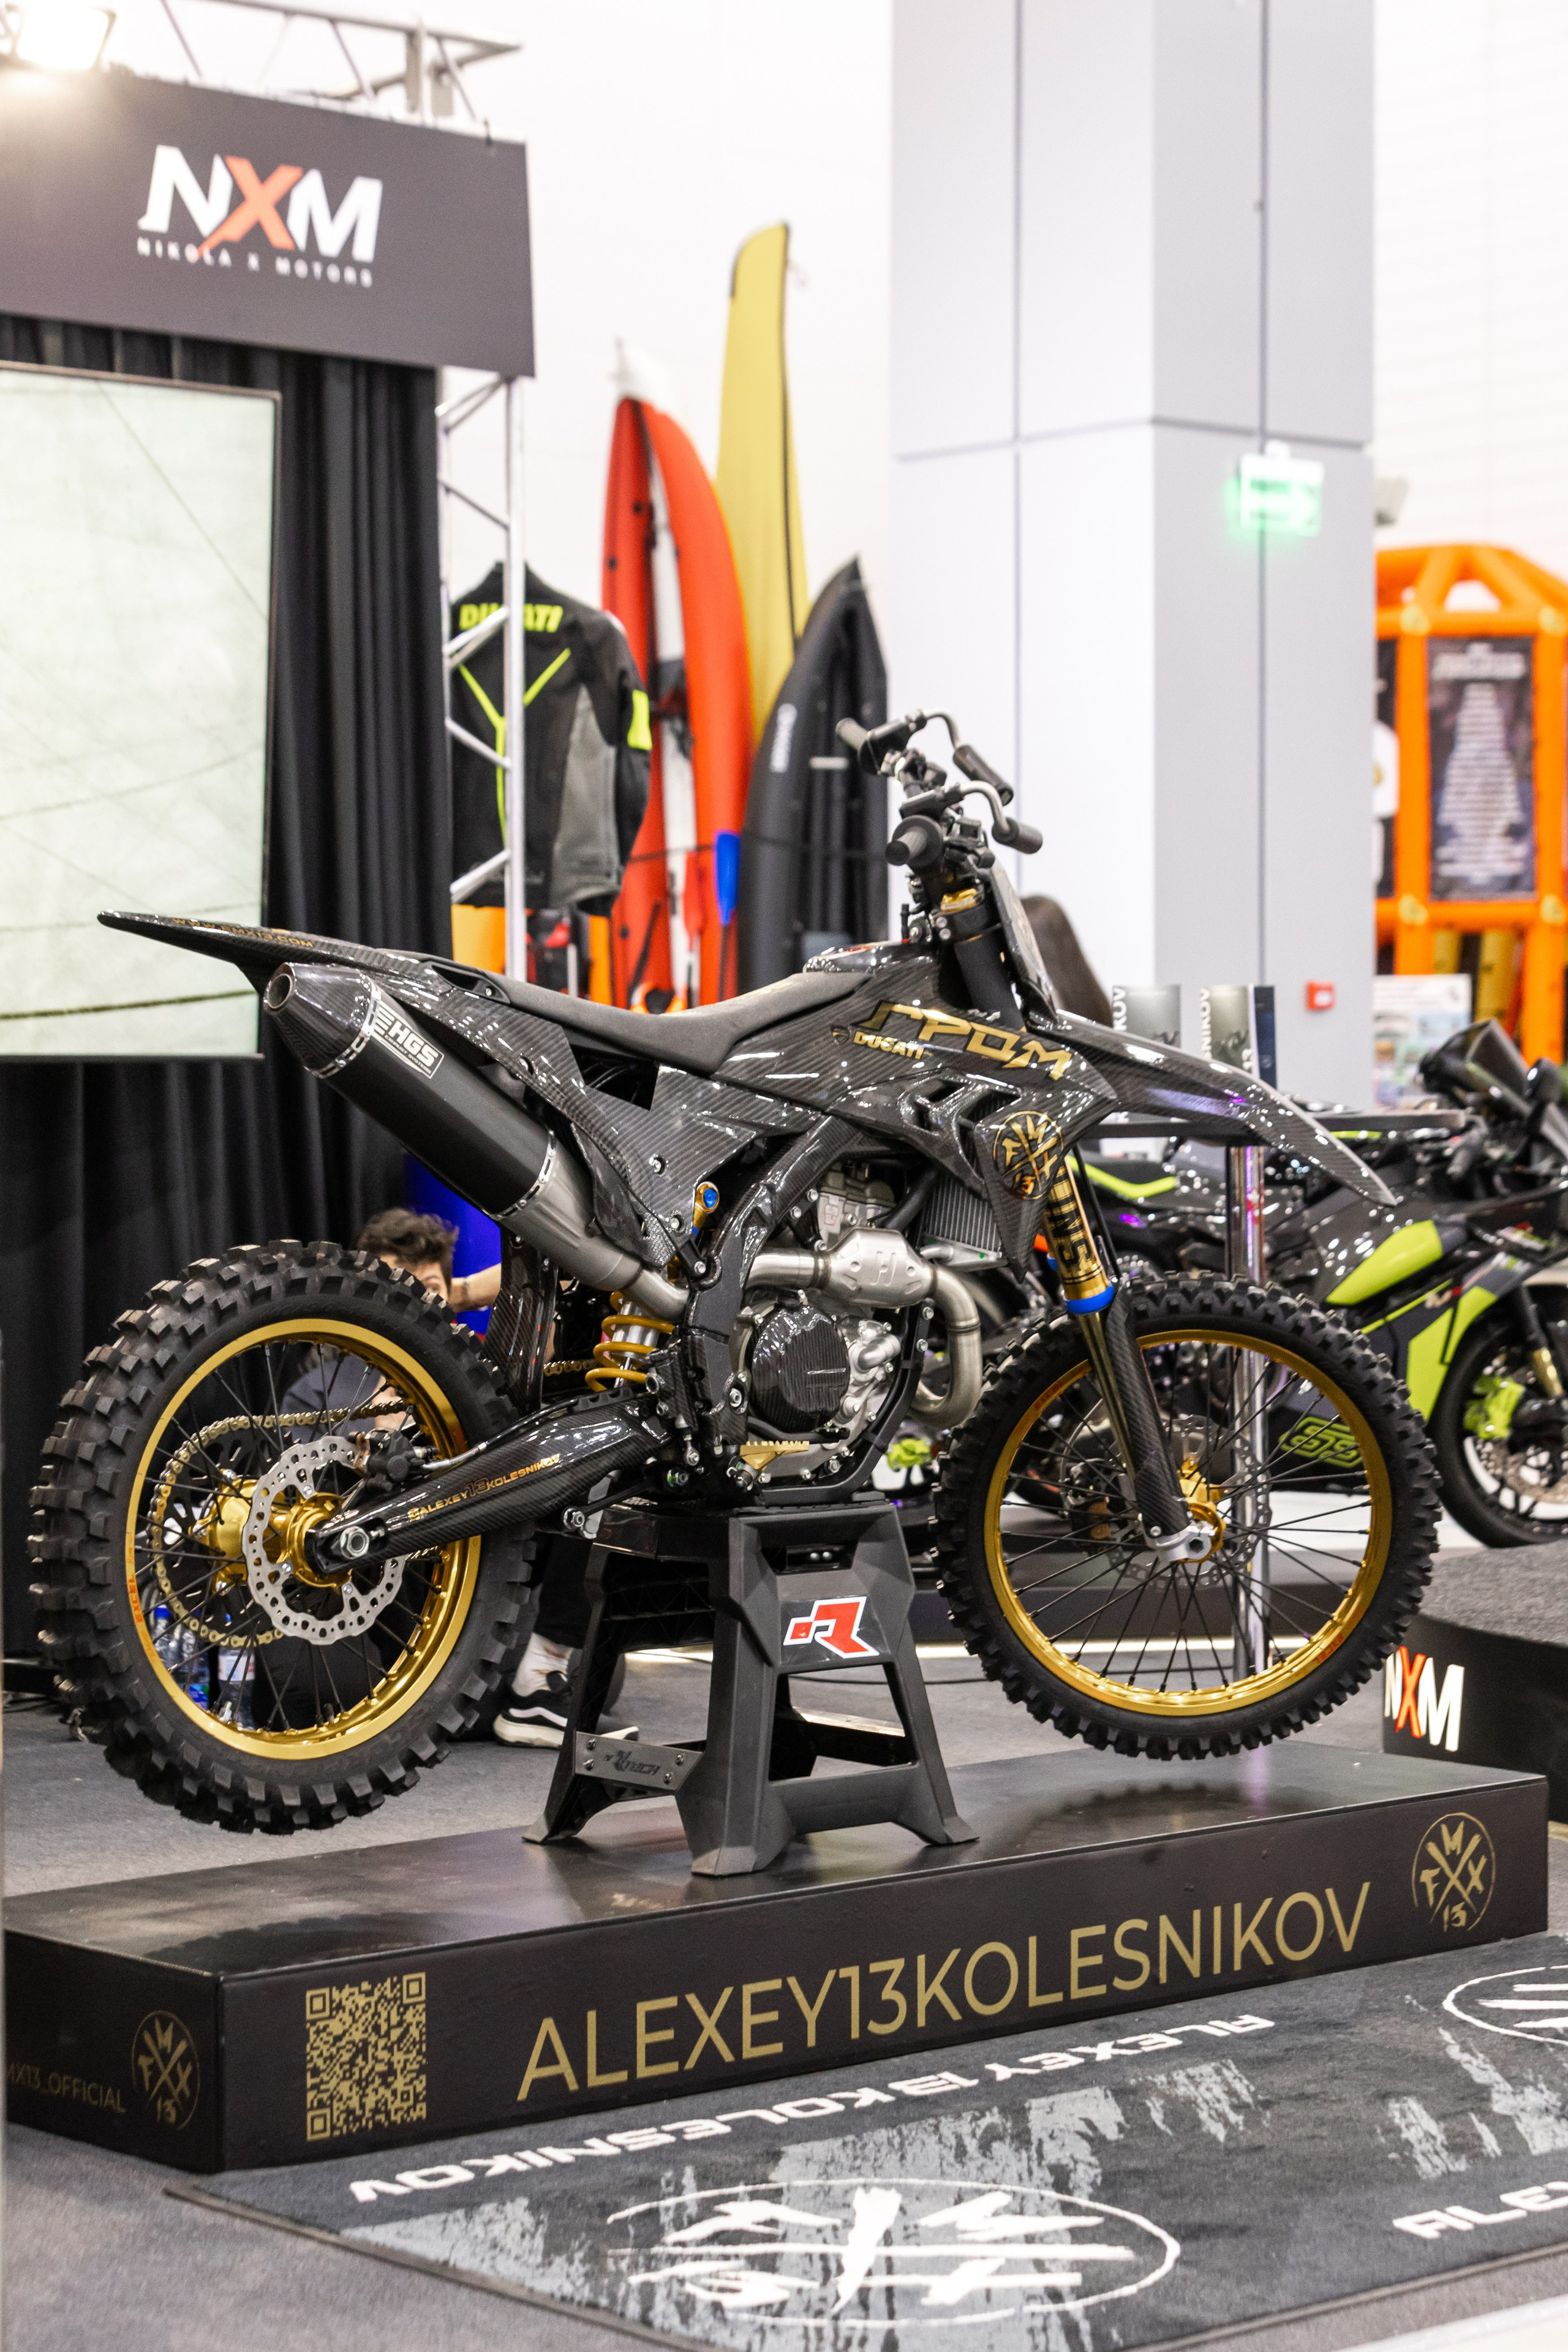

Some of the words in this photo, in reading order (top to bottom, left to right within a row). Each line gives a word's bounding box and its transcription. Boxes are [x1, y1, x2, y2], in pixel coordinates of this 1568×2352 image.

[137, 144, 383, 263] NXM
[247, 252, 260, 272] X
[275, 256, 372, 288] MOTORS
[388, 1020, 439, 1066] HGS
[854, 1031, 925, 1060] DUCATI
[1385, 1646, 1465, 1752] NXM
[516, 1882, 1370, 2101] ALEXEY13KOLESNIKOV
